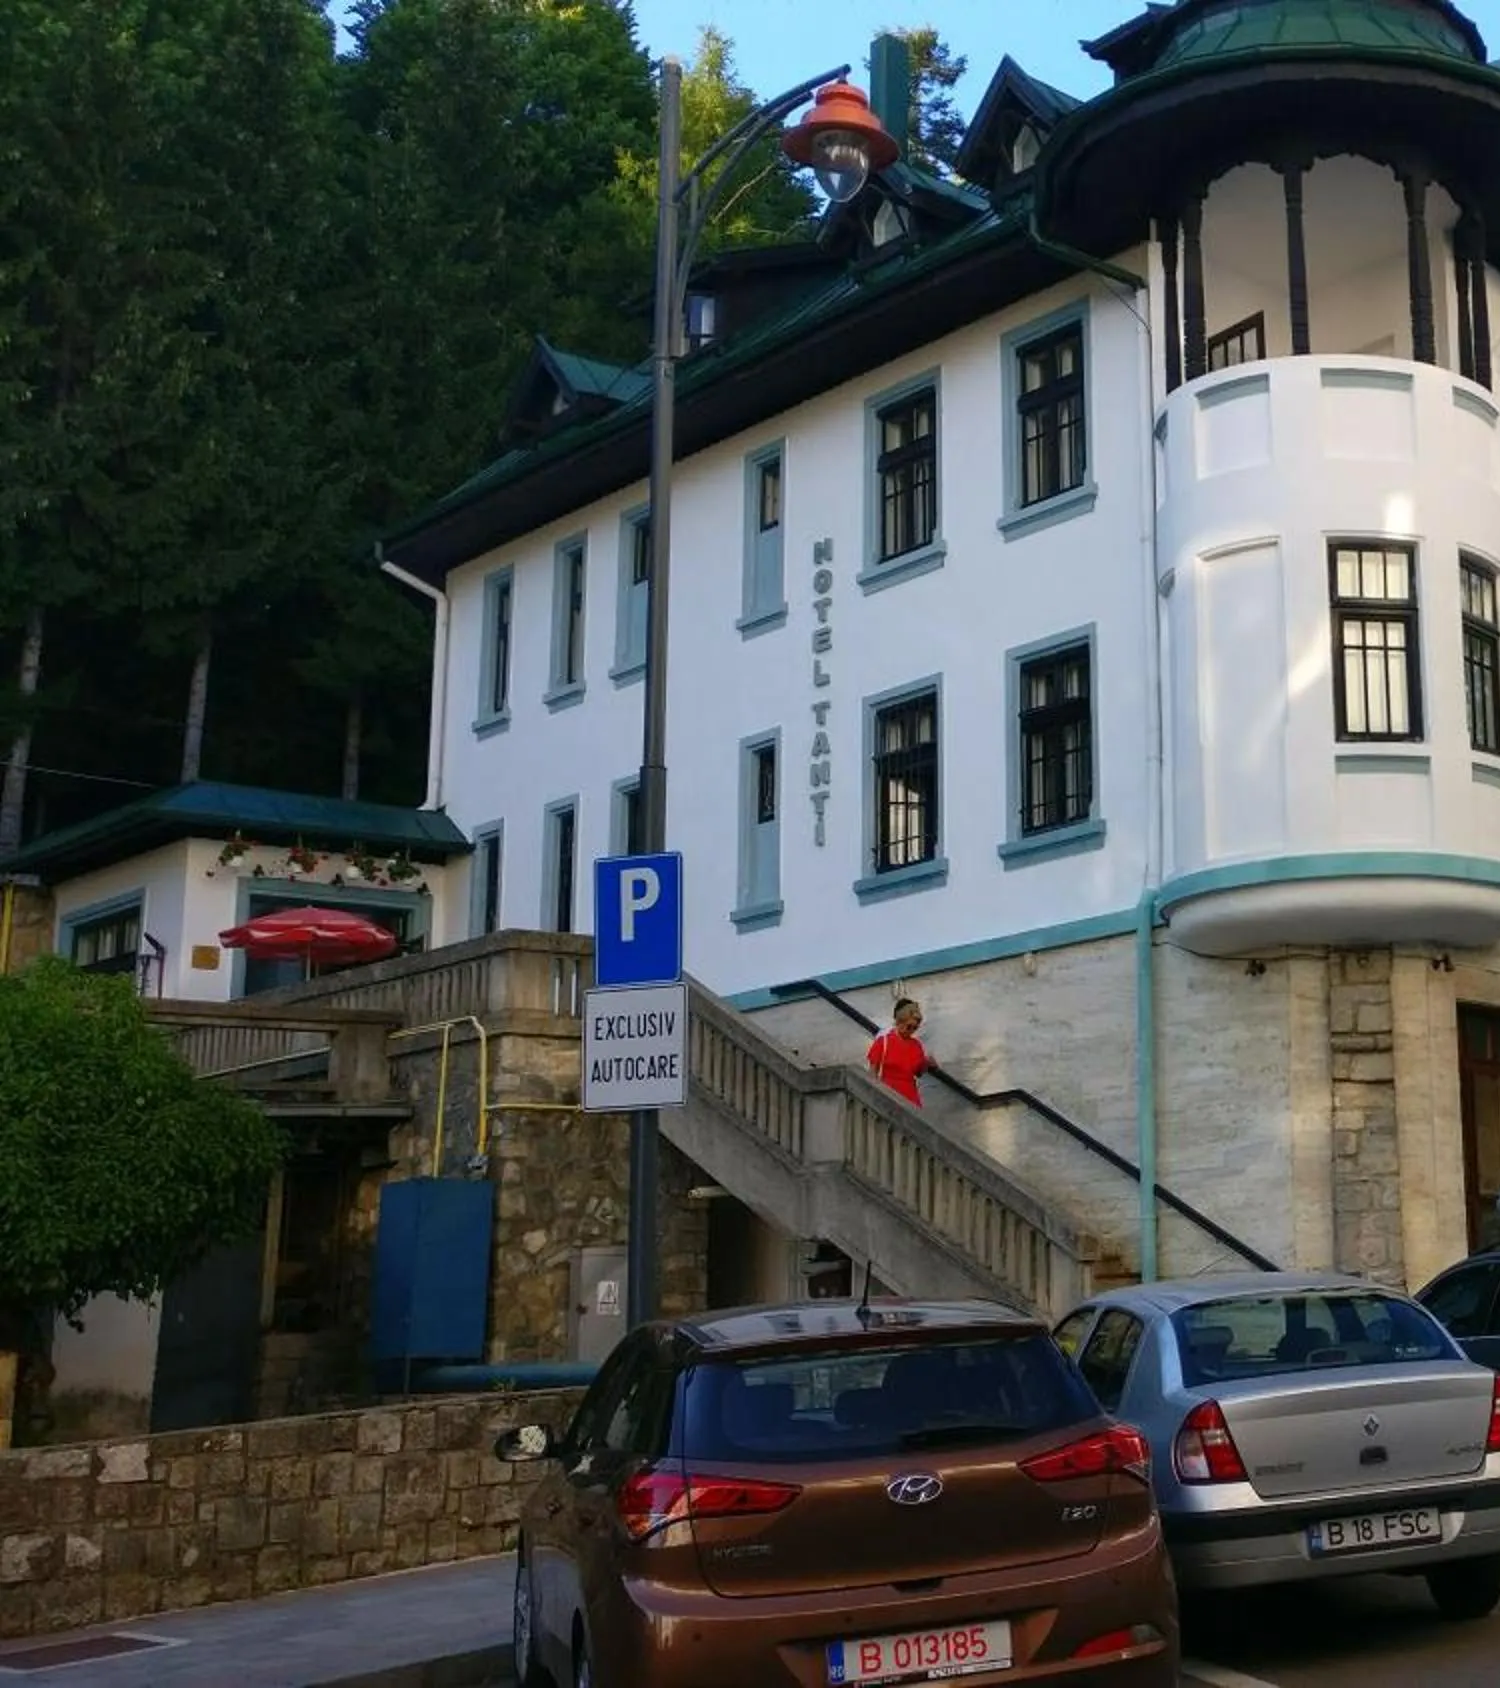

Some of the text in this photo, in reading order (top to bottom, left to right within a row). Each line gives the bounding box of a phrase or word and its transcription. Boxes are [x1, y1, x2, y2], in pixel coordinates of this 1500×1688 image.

[809, 538, 834, 848] HOTEL TANTI
[620, 867, 661, 943] P
[594, 1011, 676, 1041] EXCLUSIV
[590, 1054, 680, 1083] AUTOCARE
[1328, 1510, 1431, 1546] B 18 FSC
[859, 1642, 882, 1675] B
[893, 1627, 988, 1669] 013185
